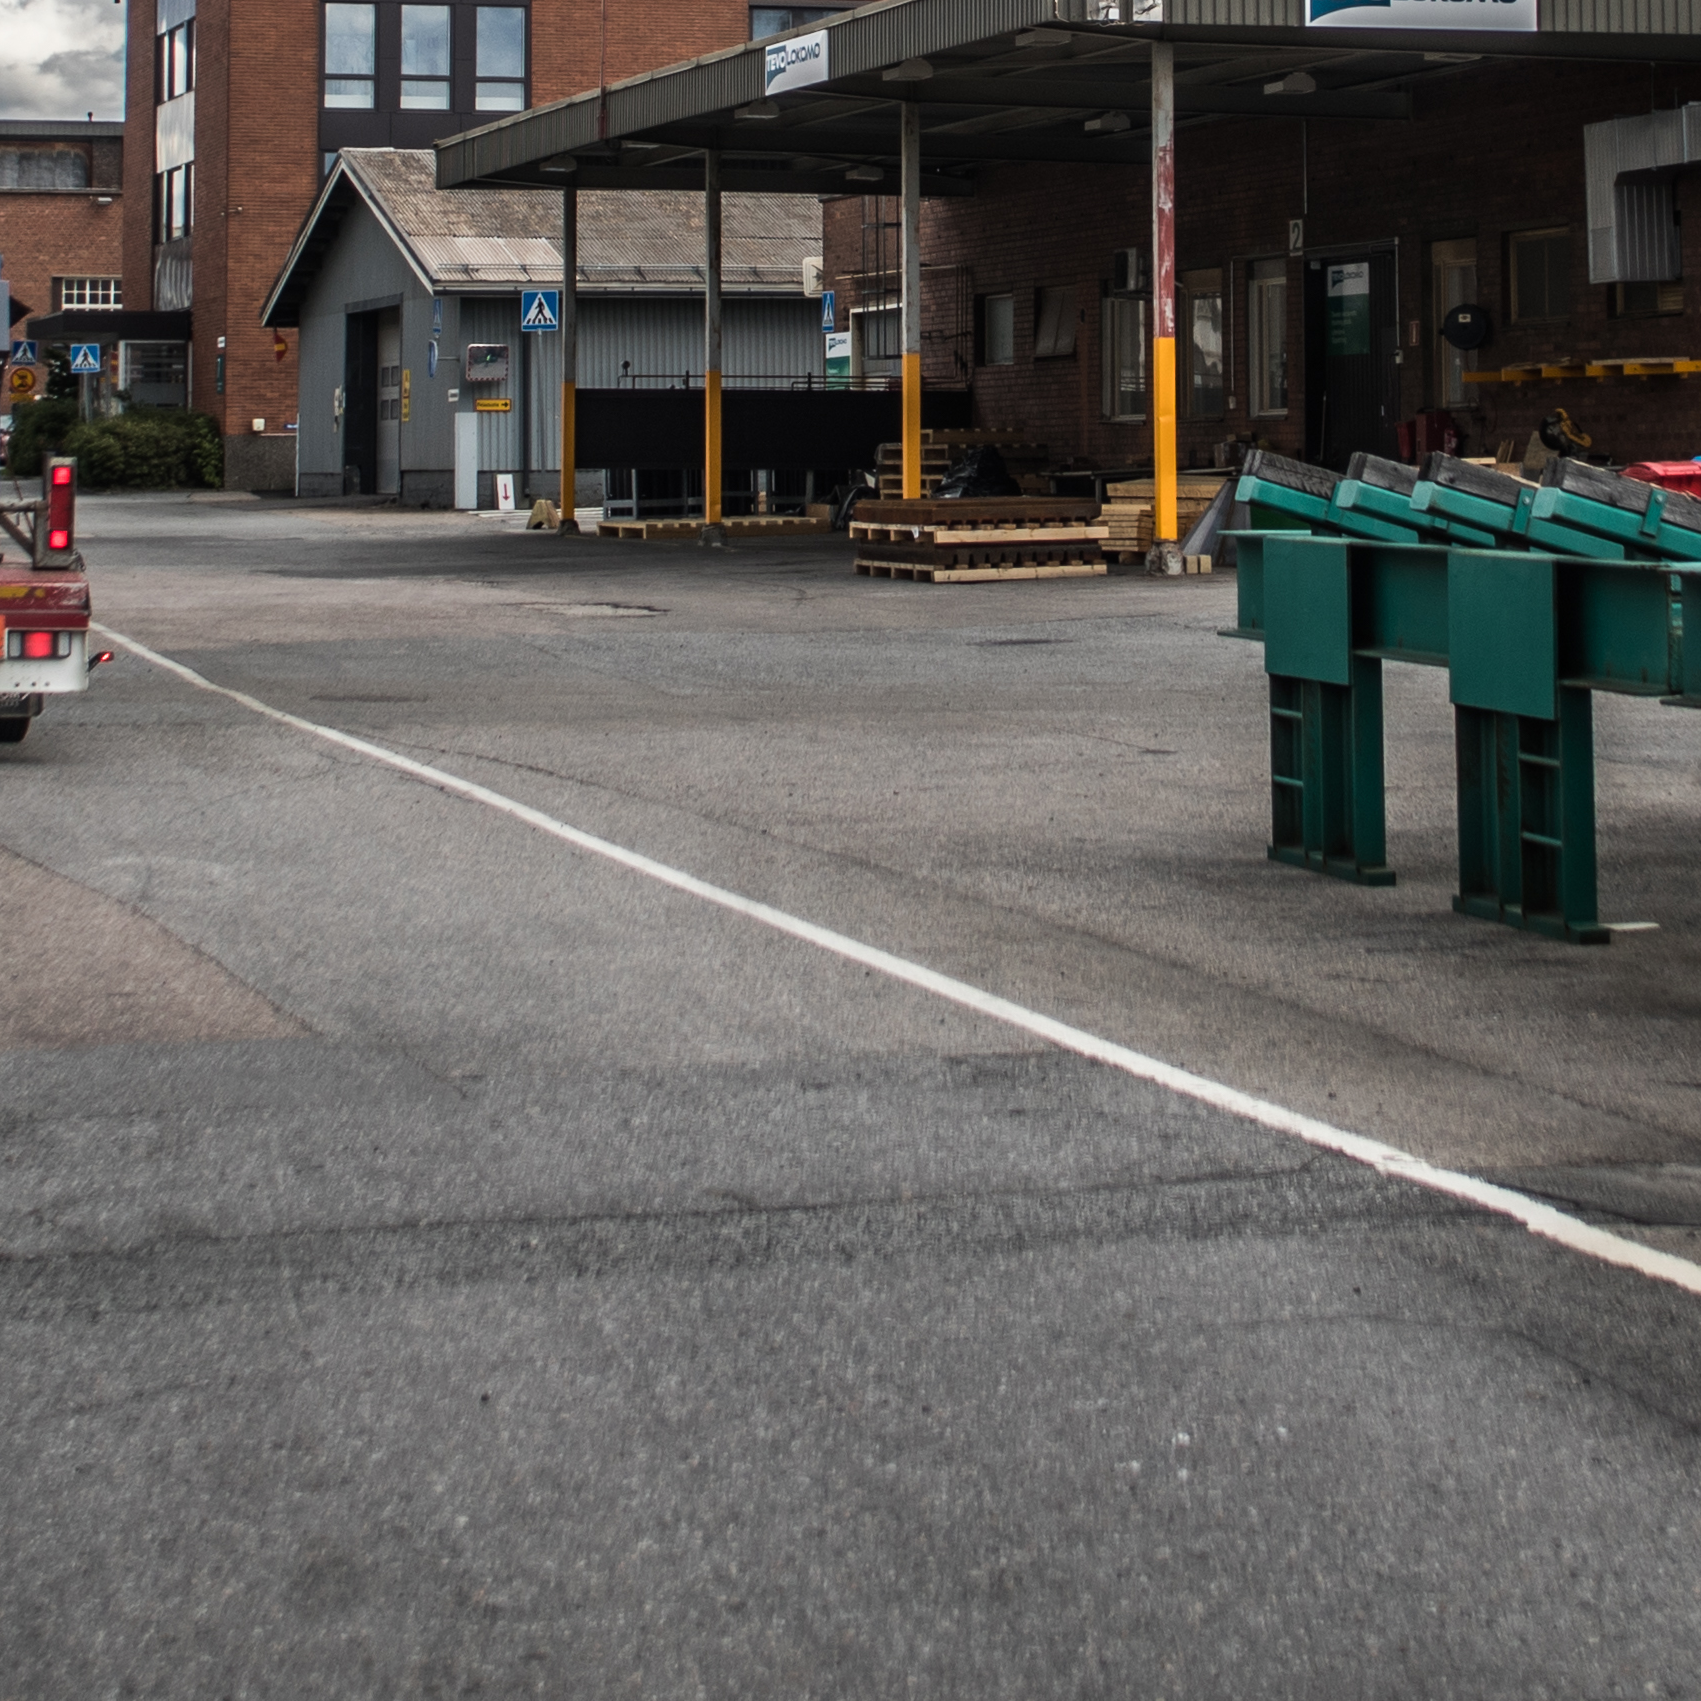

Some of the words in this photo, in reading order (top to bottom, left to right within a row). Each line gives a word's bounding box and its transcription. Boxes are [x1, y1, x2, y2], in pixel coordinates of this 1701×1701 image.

[767, 51, 786, 72] TEVO
[787, 43, 820, 66] LOKOMO
[1292, 222, 1301, 250] 2
